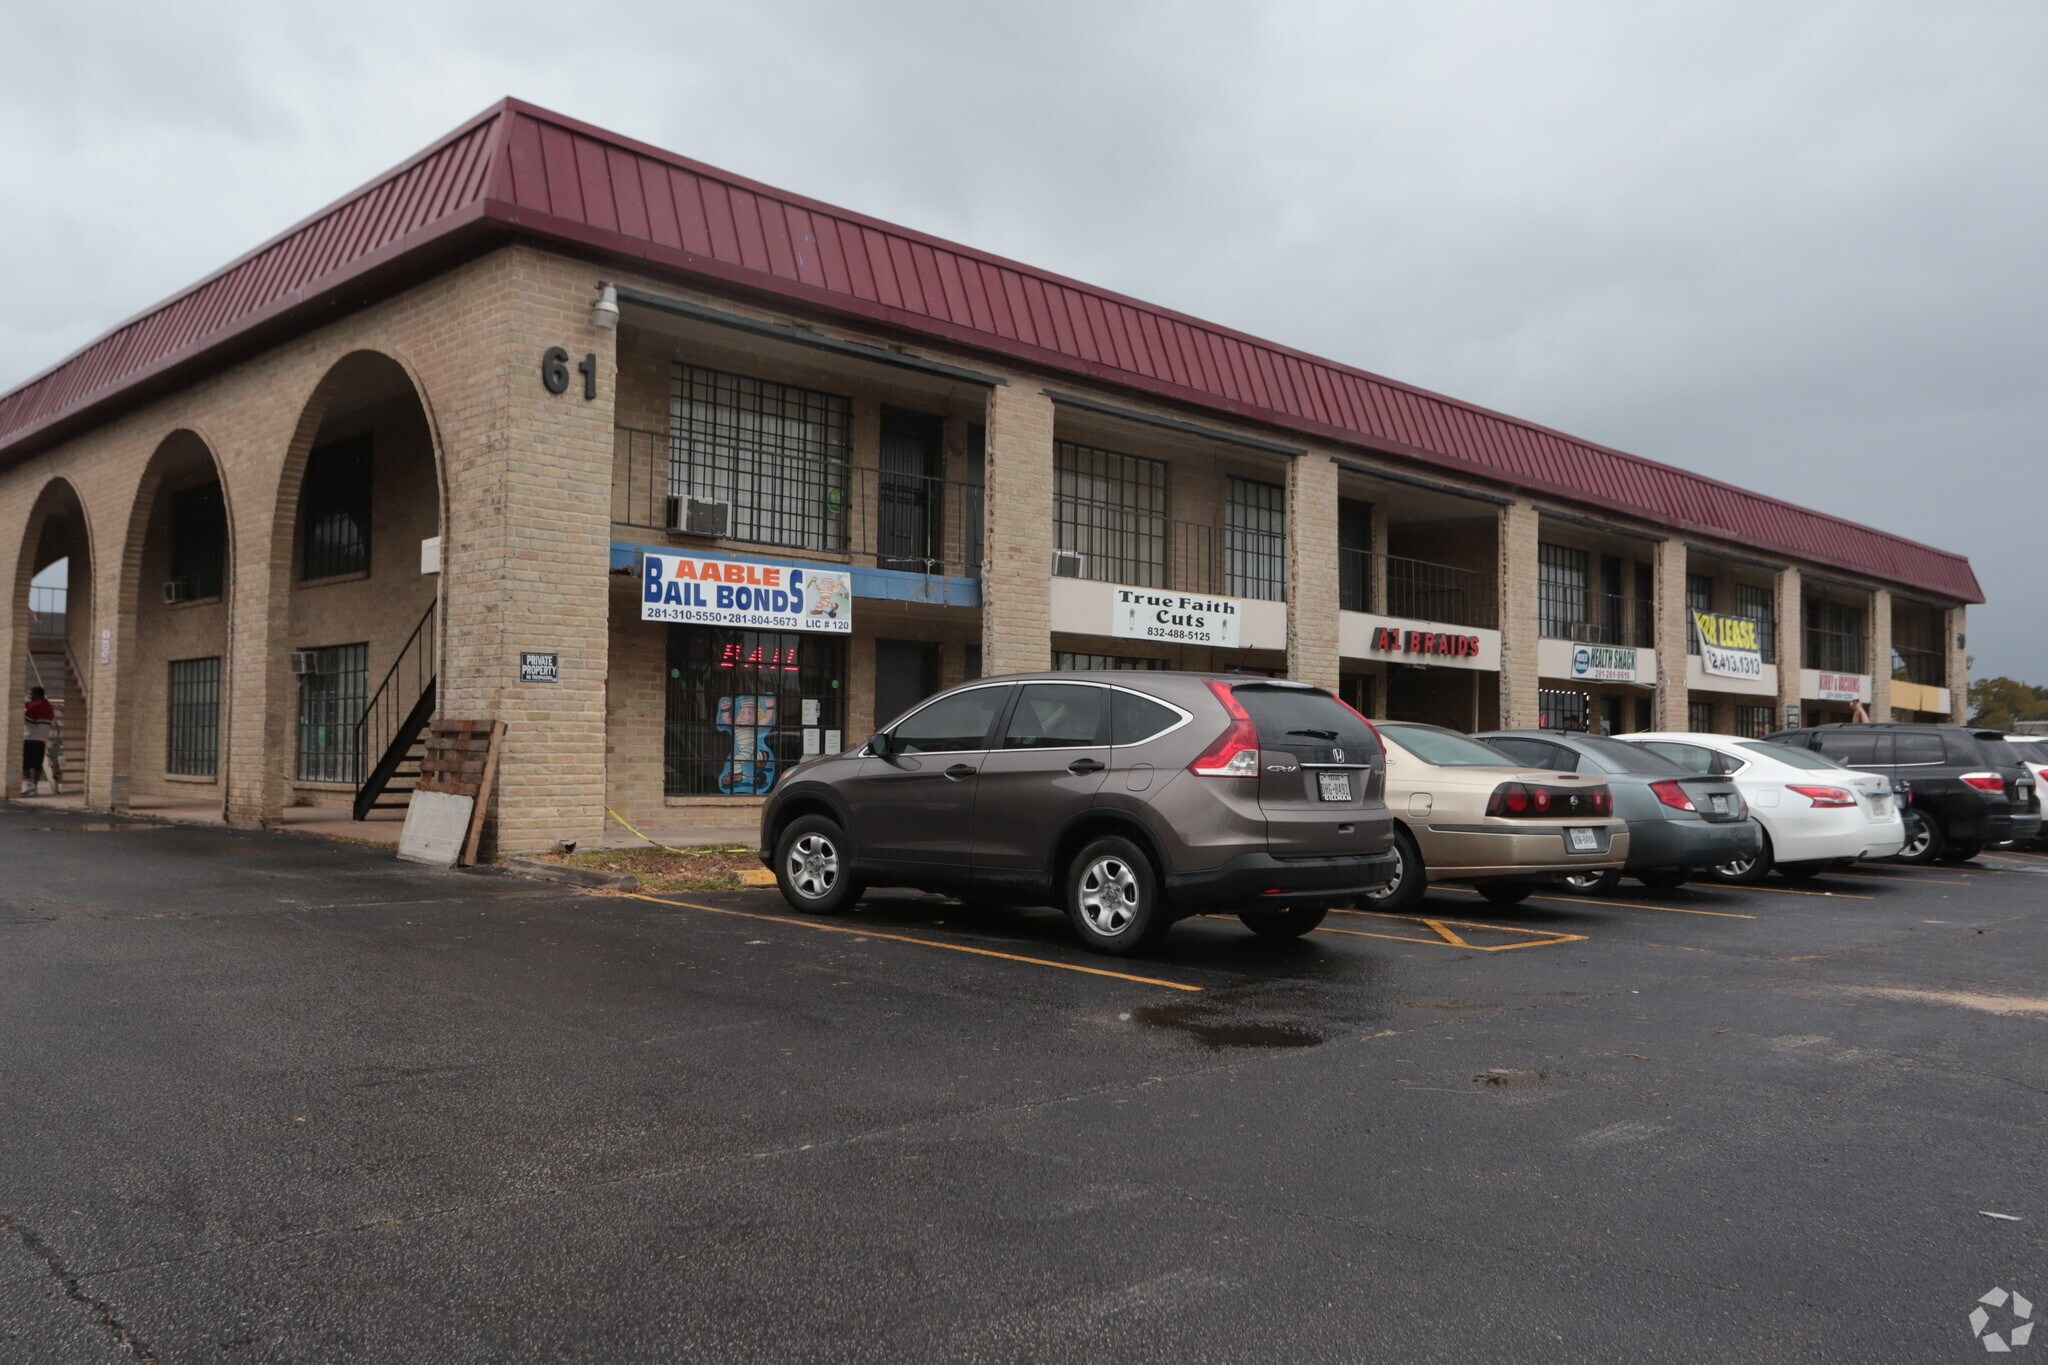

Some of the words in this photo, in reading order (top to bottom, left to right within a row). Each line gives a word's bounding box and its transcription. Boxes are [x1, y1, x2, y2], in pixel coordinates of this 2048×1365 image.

[542, 346, 597, 400] 61
[644, 556, 707, 608] BAIL
[716, 569, 804, 614] BONDS
[675, 559, 781, 587] AABLE
[1118, 590, 1173, 608] True
[1178, 597, 1235, 615] Faith
[647, 607, 722, 623] 281-310-5550
[728, 613, 798, 627] 281-804-5673
[806, 619, 822, 629] LIC
[833, 620, 849, 630] 120
[1156, 609, 1205, 628] Cuts
[1147, 626, 1211, 642] 832-488-5125
[1376, 627, 1401, 650] A1
[1408, 631, 1480, 657] BRAIDS
[1719, 617, 1759, 651] LEASE
[522, 664, 557, 676] PROPERTY
[526, 655, 553, 666] PRIVATE
[1590, 647, 1613, 669] HEALTH
[1614, 649, 1636, 671] SHACK
